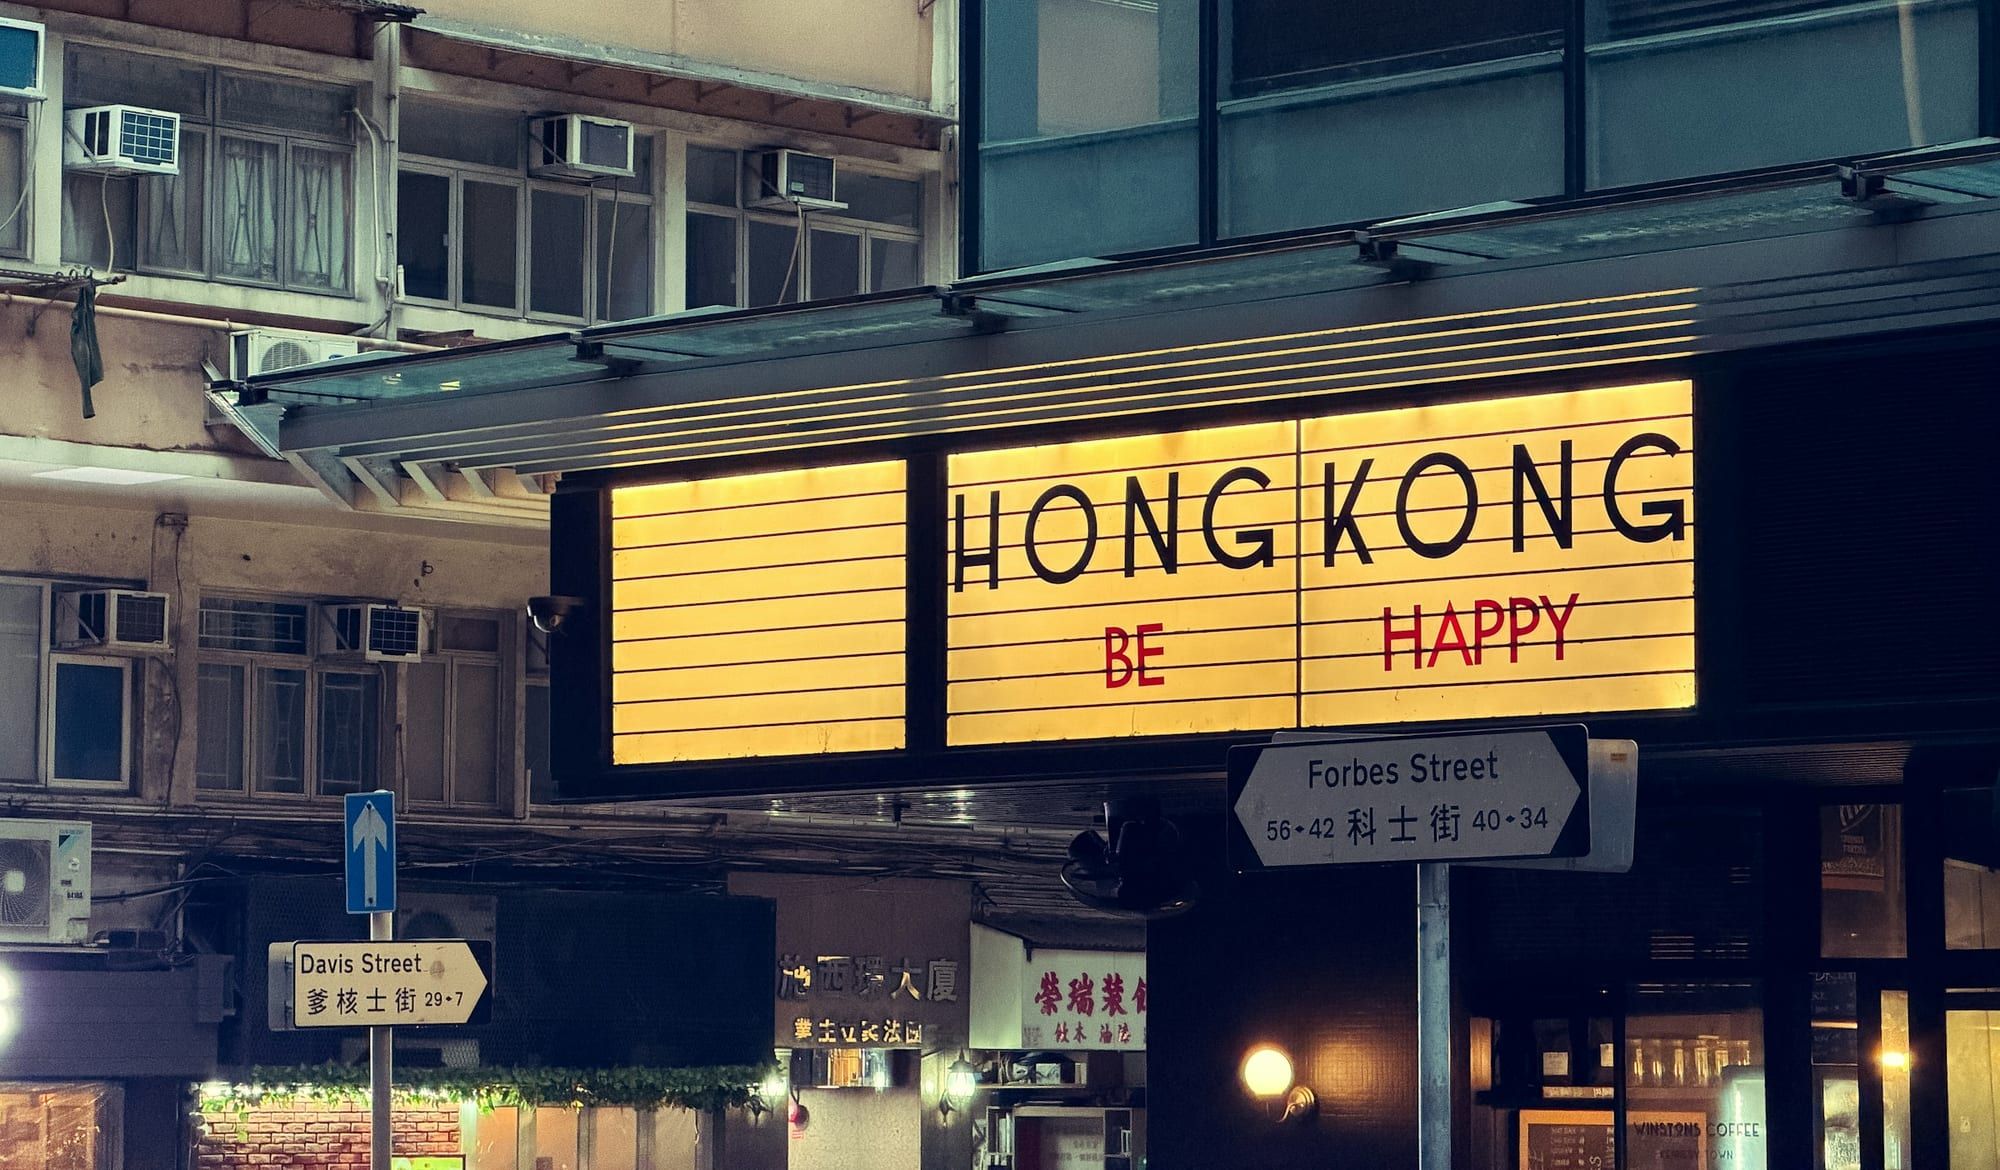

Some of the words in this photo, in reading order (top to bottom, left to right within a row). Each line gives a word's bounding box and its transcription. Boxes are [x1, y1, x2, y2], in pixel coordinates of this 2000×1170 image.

[952, 465, 1275, 593] HONG
[1323, 432, 1686, 568] KONG
[1103, 621, 1166, 689] BE
[1382, 592, 1580, 672] HAPPY
[1309, 757, 1399, 788] Forbes
[1410, 750, 1498, 782] Street
[1346, 804, 1461, 845] 科士街
[301, 953, 355, 974] Davis
[361, 952, 422, 974] Street
[306, 987, 417, 1016] 爹核士街
[1633, 1122, 1702, 1138] WINSTONS
[1706, 1122, 1760, 1138] COFFEE
